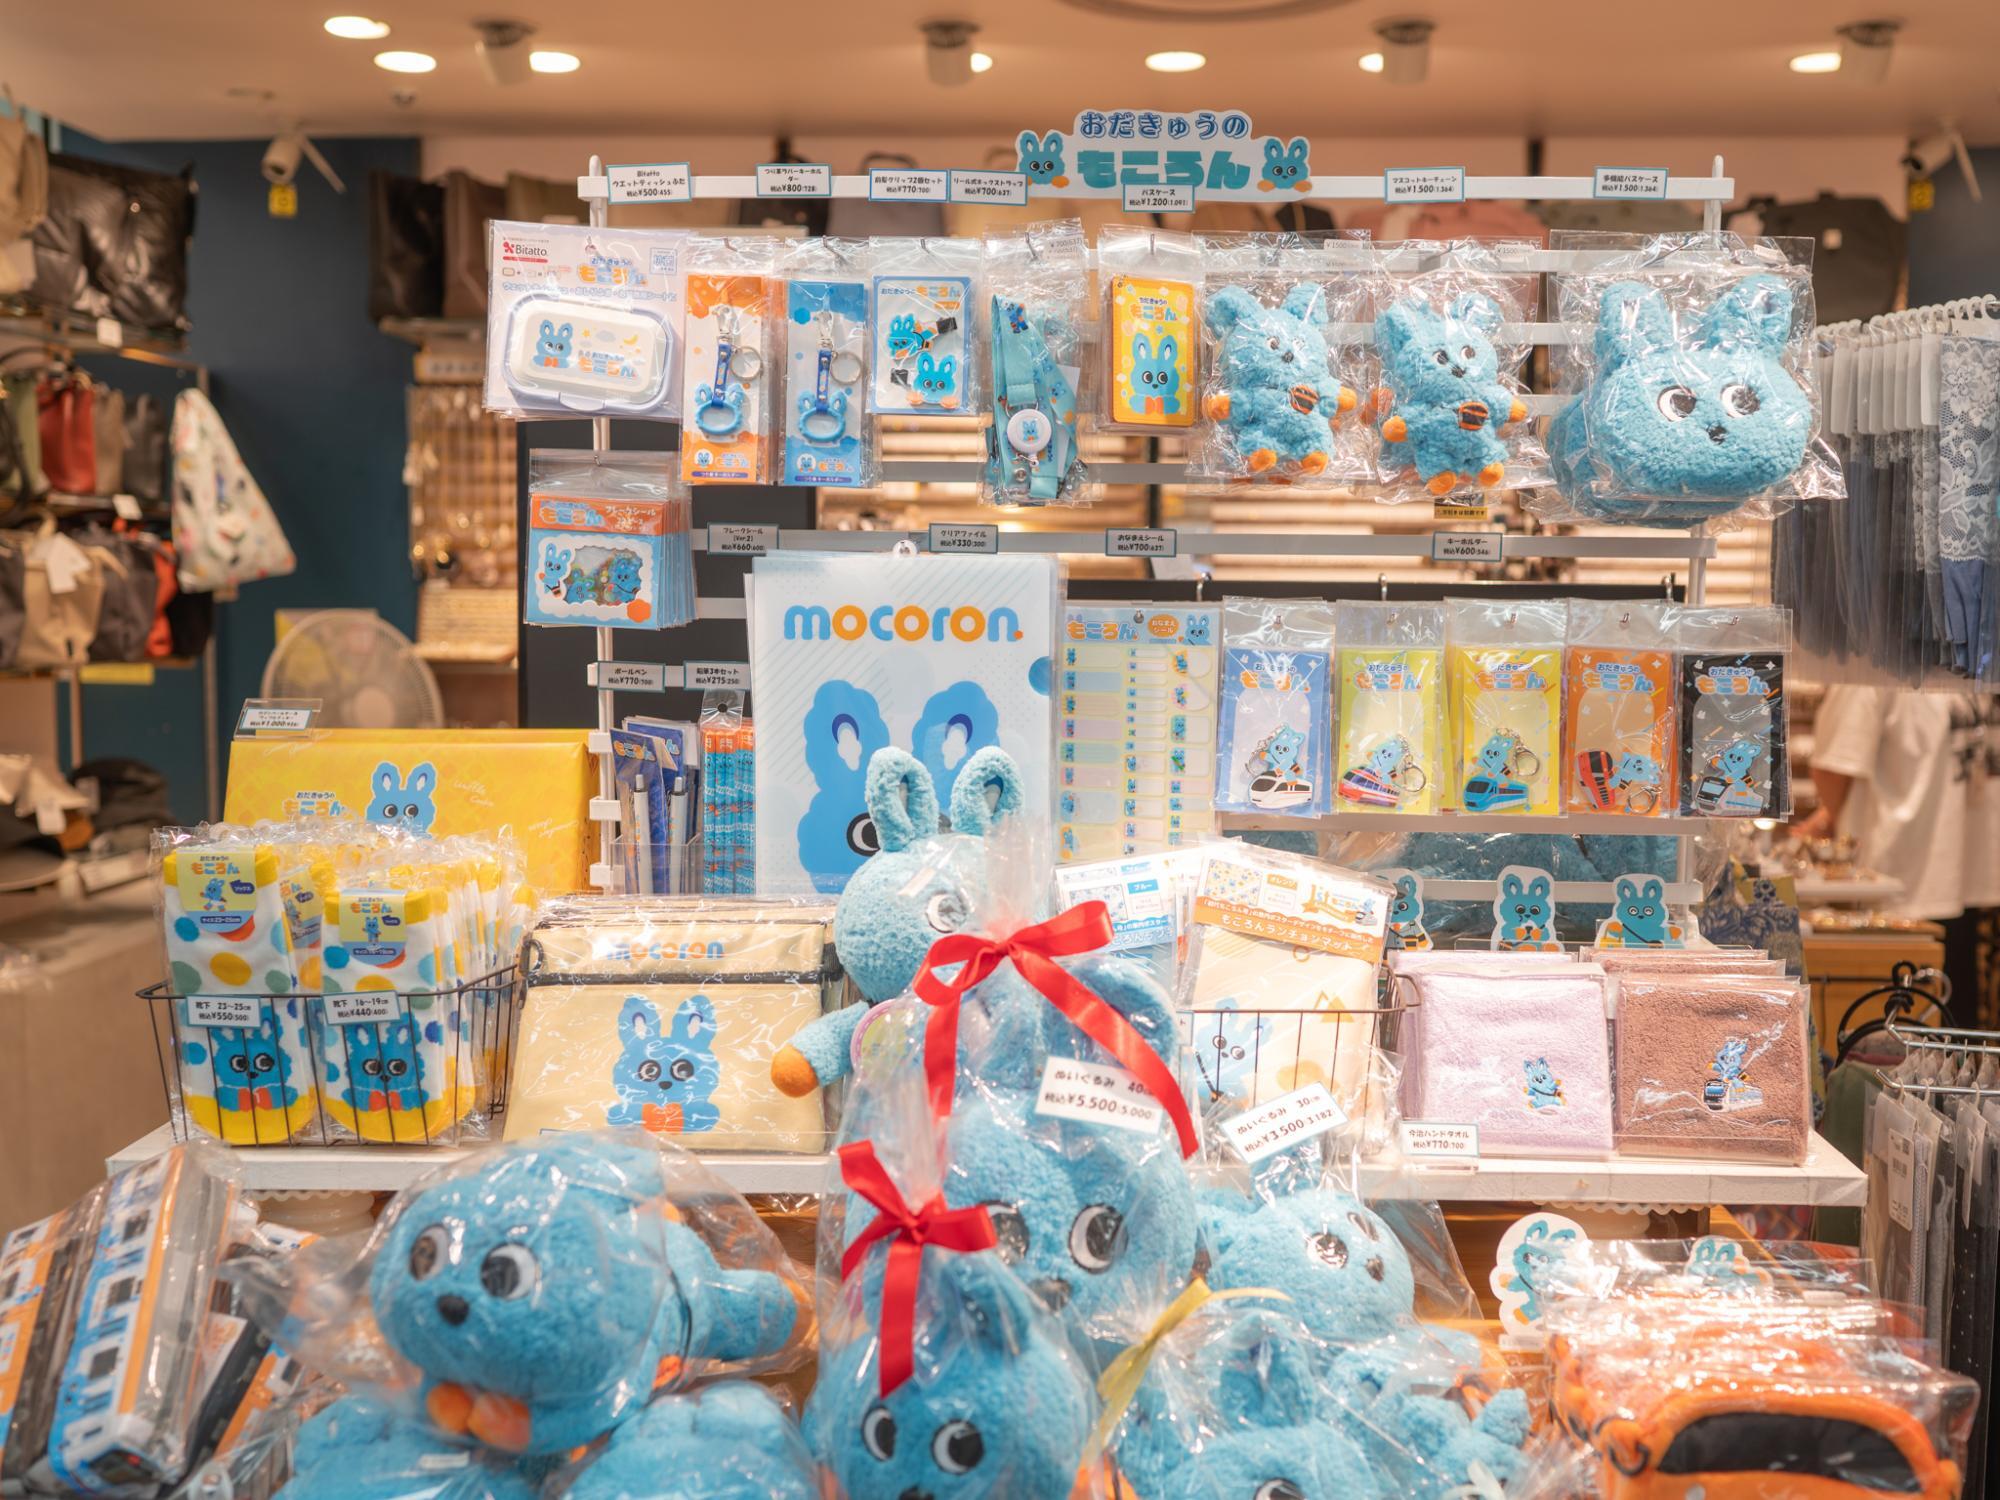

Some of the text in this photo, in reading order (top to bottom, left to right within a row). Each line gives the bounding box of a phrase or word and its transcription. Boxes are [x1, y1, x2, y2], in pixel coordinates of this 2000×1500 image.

[1081, 112, 1248, 141] おだきゅうの
[1077, 150, 1250, 190] もころん
[1141, 188, 1176, 197] パスケース
[515, 244, 548, 257] Bitatto
[940, 529, 987, 538] クリアファイル
[195, 1000, 211, 1010] 靴下
[332, 999, 348, 1009] 靴下
[1054, 1070, 1115, 1089] ぬいぐるみ
[1237, 1107, 1287, 1135] ぬいぐるみ
[1408, 1128, 1470, 1139] 今治ハンドタオル
